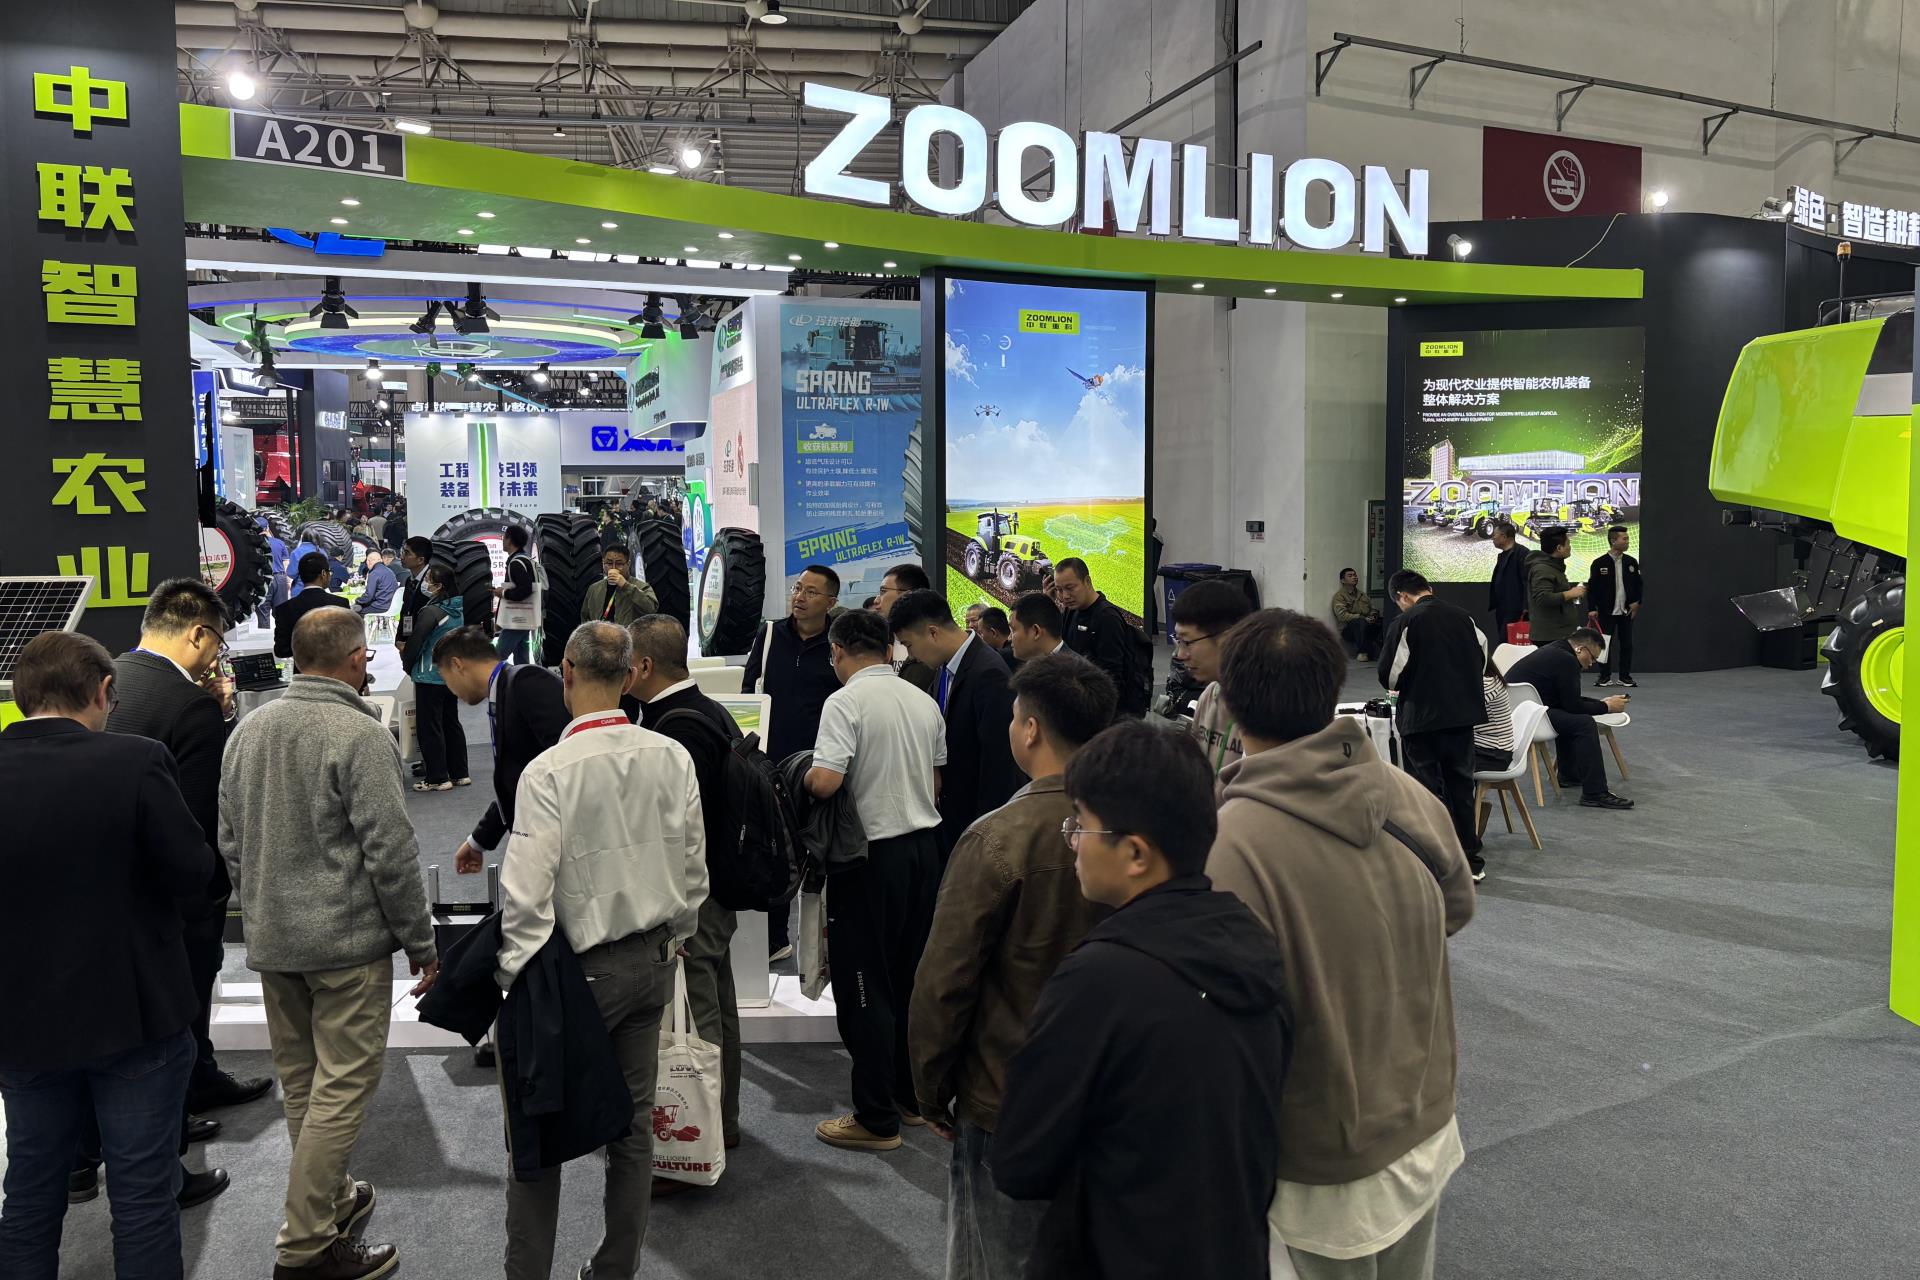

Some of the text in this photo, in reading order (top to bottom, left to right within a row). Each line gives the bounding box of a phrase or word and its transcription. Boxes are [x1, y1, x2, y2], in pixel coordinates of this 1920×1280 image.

[255, 118, 387, 172] A201
[802, 81, 1430, 256] ZOOMLION
[1026, 313, 1073, 323] ZOOMLION
[34, 65, 151, 608] 中联智慧农业
[795, 369, 872, 395] SPRING
[1423, 376, 1592, 392] 为现代农业提供智能农机装备
[796, 396, 890, 411] ULTRAFLEX R-1W
[1423, 393, 1500, 407] 整体解决方案
[797, 527, 858, 559] SPRING
[835, 540, 884, 562] ULTRAFLEX
[856, 970, 867, 1009] ESSENTIALS
